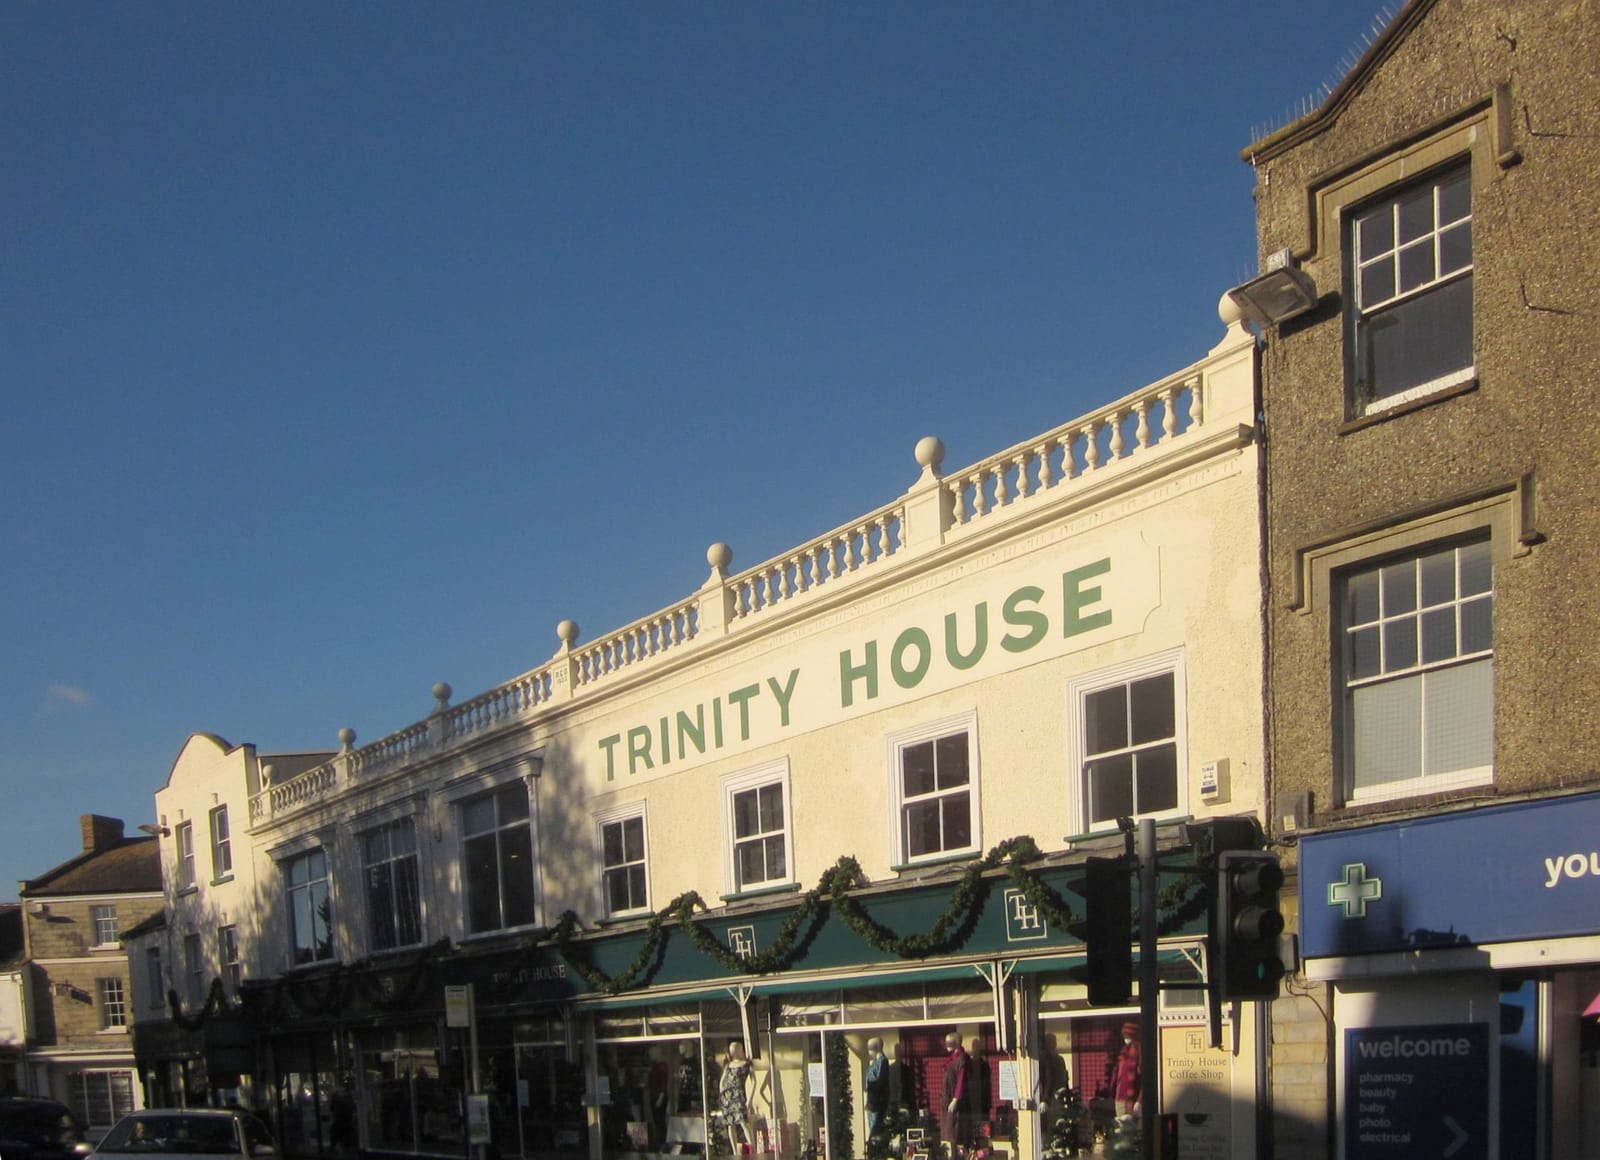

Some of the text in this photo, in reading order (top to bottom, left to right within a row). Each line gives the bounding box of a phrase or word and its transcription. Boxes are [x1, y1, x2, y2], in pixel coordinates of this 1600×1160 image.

[598, 557, 1113, 782] TRINITY HOUSE
[1359, 1035, 1471, 1058] welcome
[1167, 1056, 1227, 1068] Trinity House
[1169, 1069, 1225, 1080] Coffee Shop
[1359, 1072, 1415, 1085] pharmacy
[1359, 1087, 1398, 1100] beauty
[1359, 1103, 1386, 1115] baby
[1359, 1117, 1392, 1129] photo
[1359, 1130, 1412, 1144] electrical
